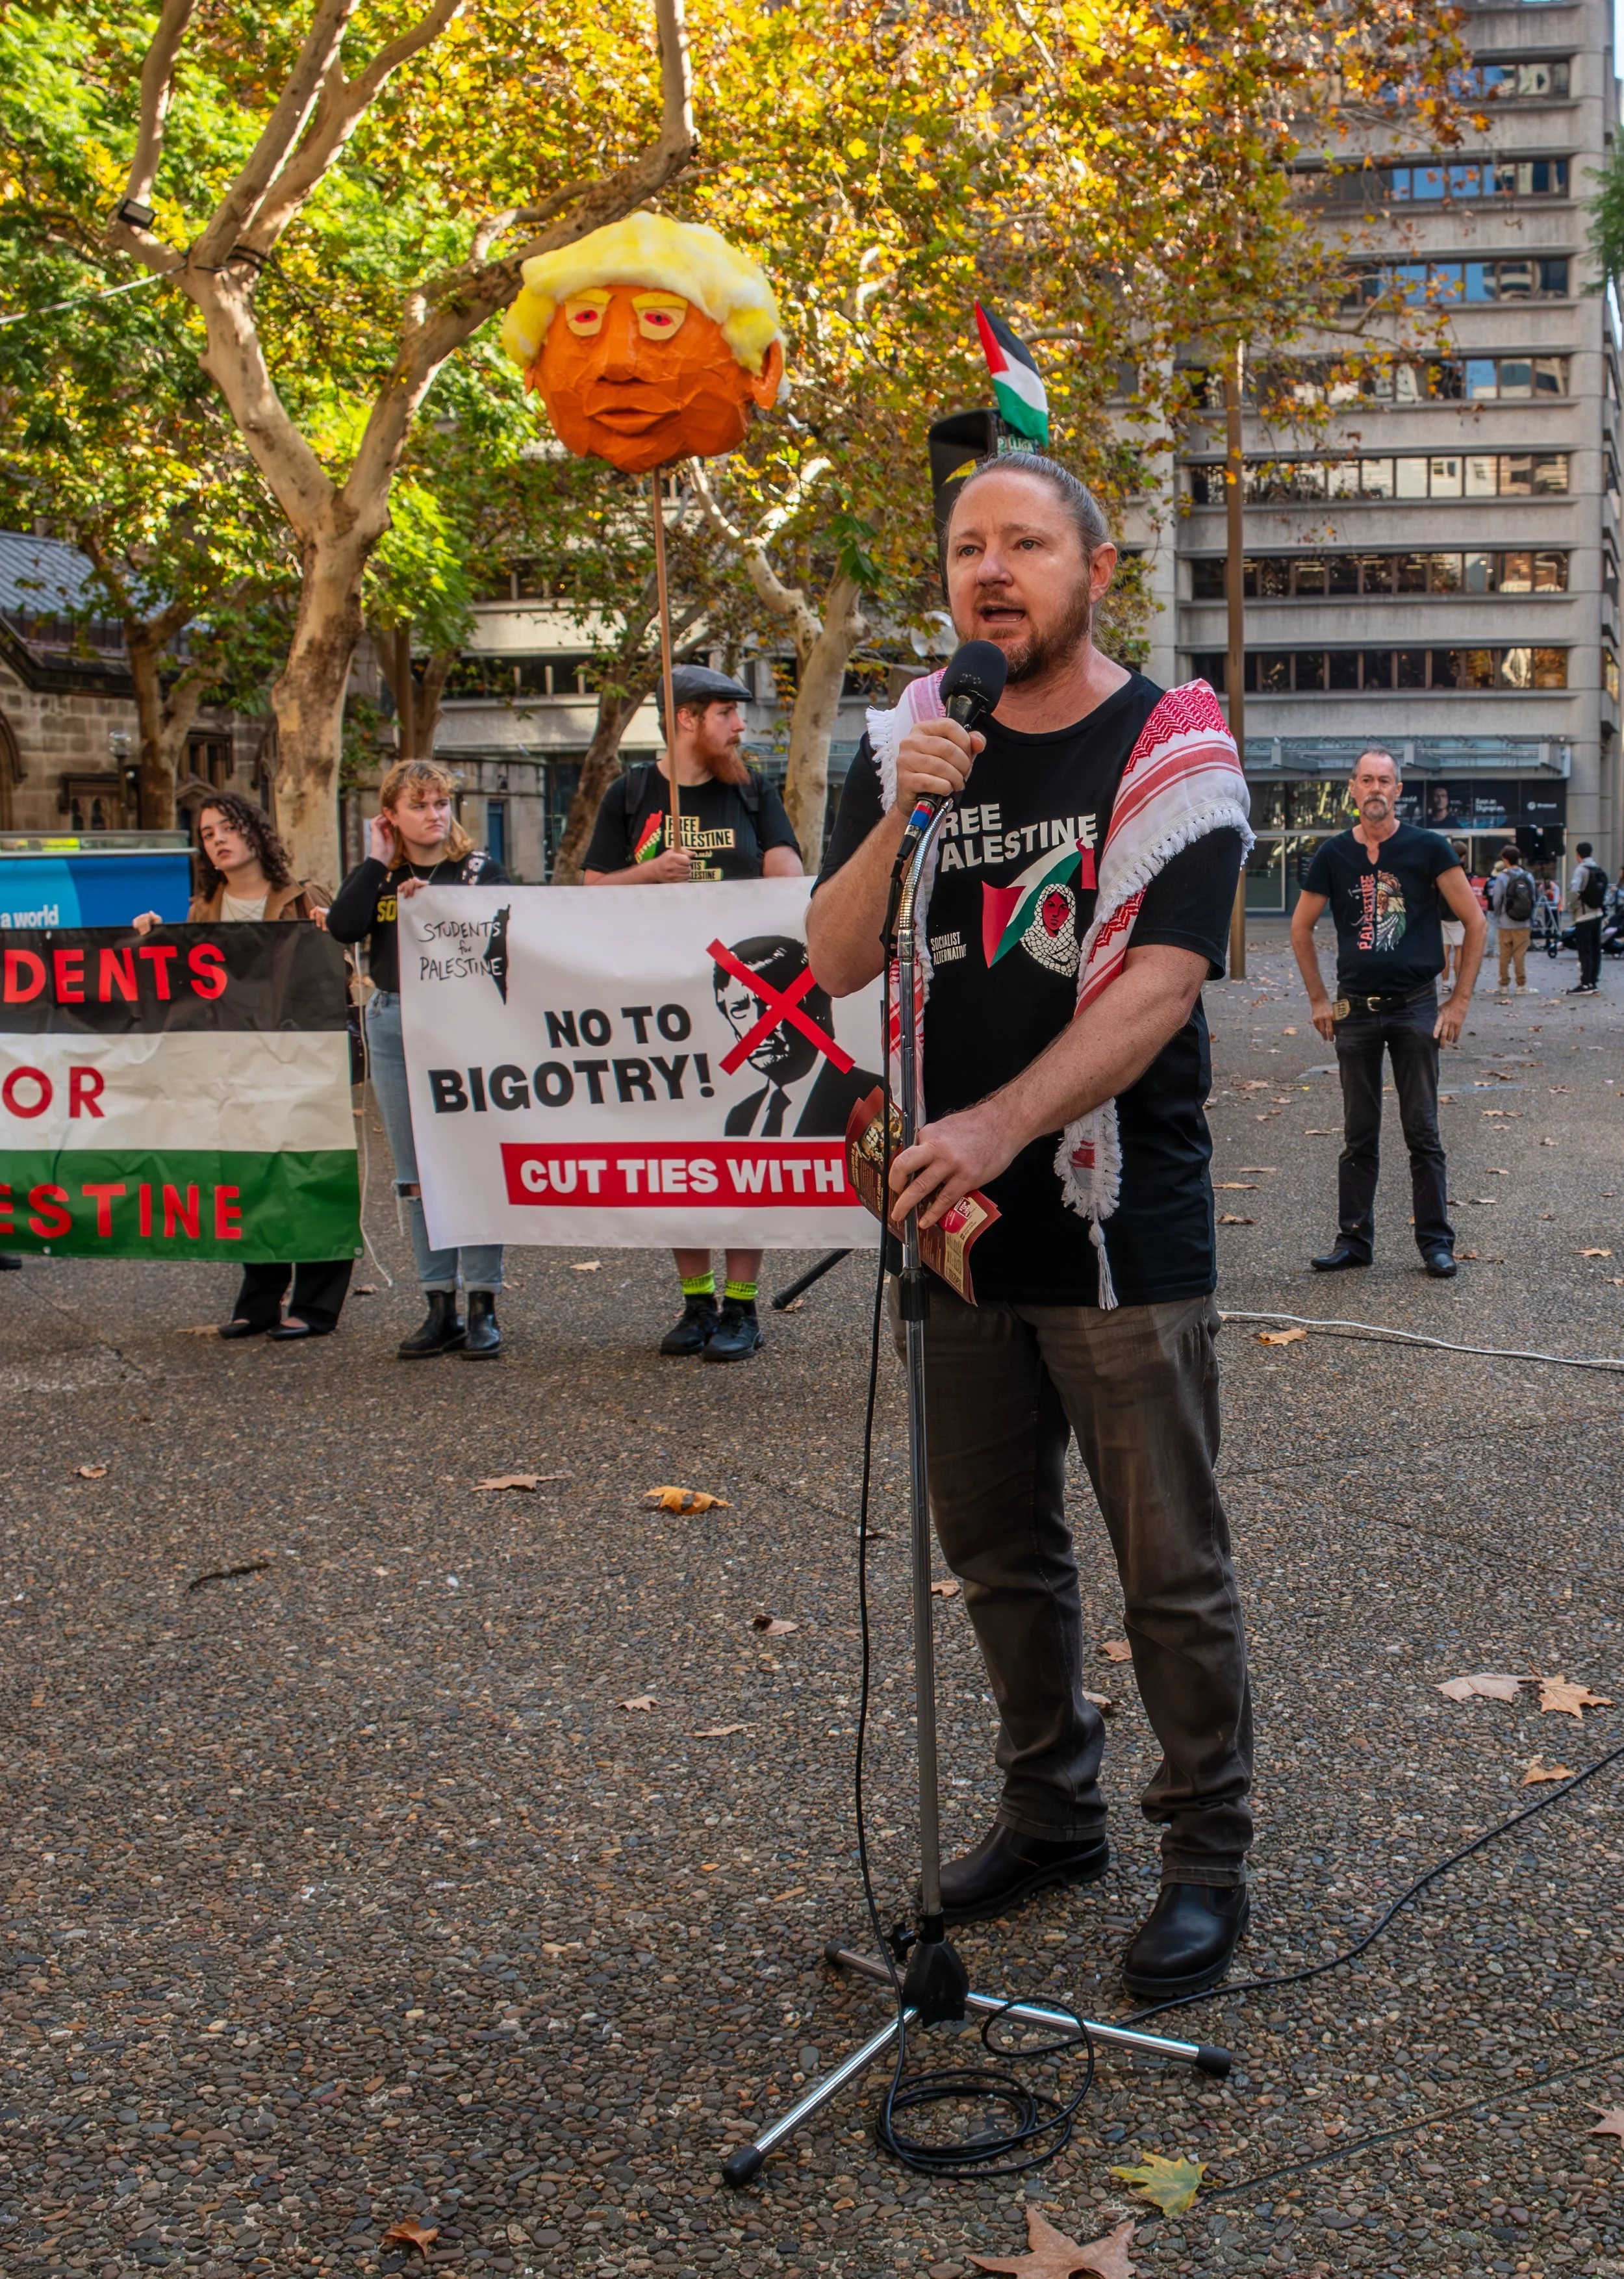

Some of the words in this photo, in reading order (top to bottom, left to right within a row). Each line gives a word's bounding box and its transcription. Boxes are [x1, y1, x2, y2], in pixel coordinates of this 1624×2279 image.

[939, 804, 1002, 839] REE
[941, 813, 1098, 872] ALESTINE
[0, 912, 11, 928] a
[13, 904, 59, 928] world
[418, 921, 501, 942] STUDENTS
[458, 939, 472, 954] for
[930, 932, 960, 952] SOCIALIST
[3, 943, 227, 1003] DENTS
[420, 956, 503, 980] PALESTINE
[544, 1008, 612, 1048] NO
[621, 1004, 691, 1044] TO
[2, 1065, 106, 1119] OR
[427, 1052, 715, 1114] BIGOTRY!
[520, 1160, 607, 1193] CUT
[616, 1159, 719, 1193] TIES
[726, 1160, 845, 1193] WITH
